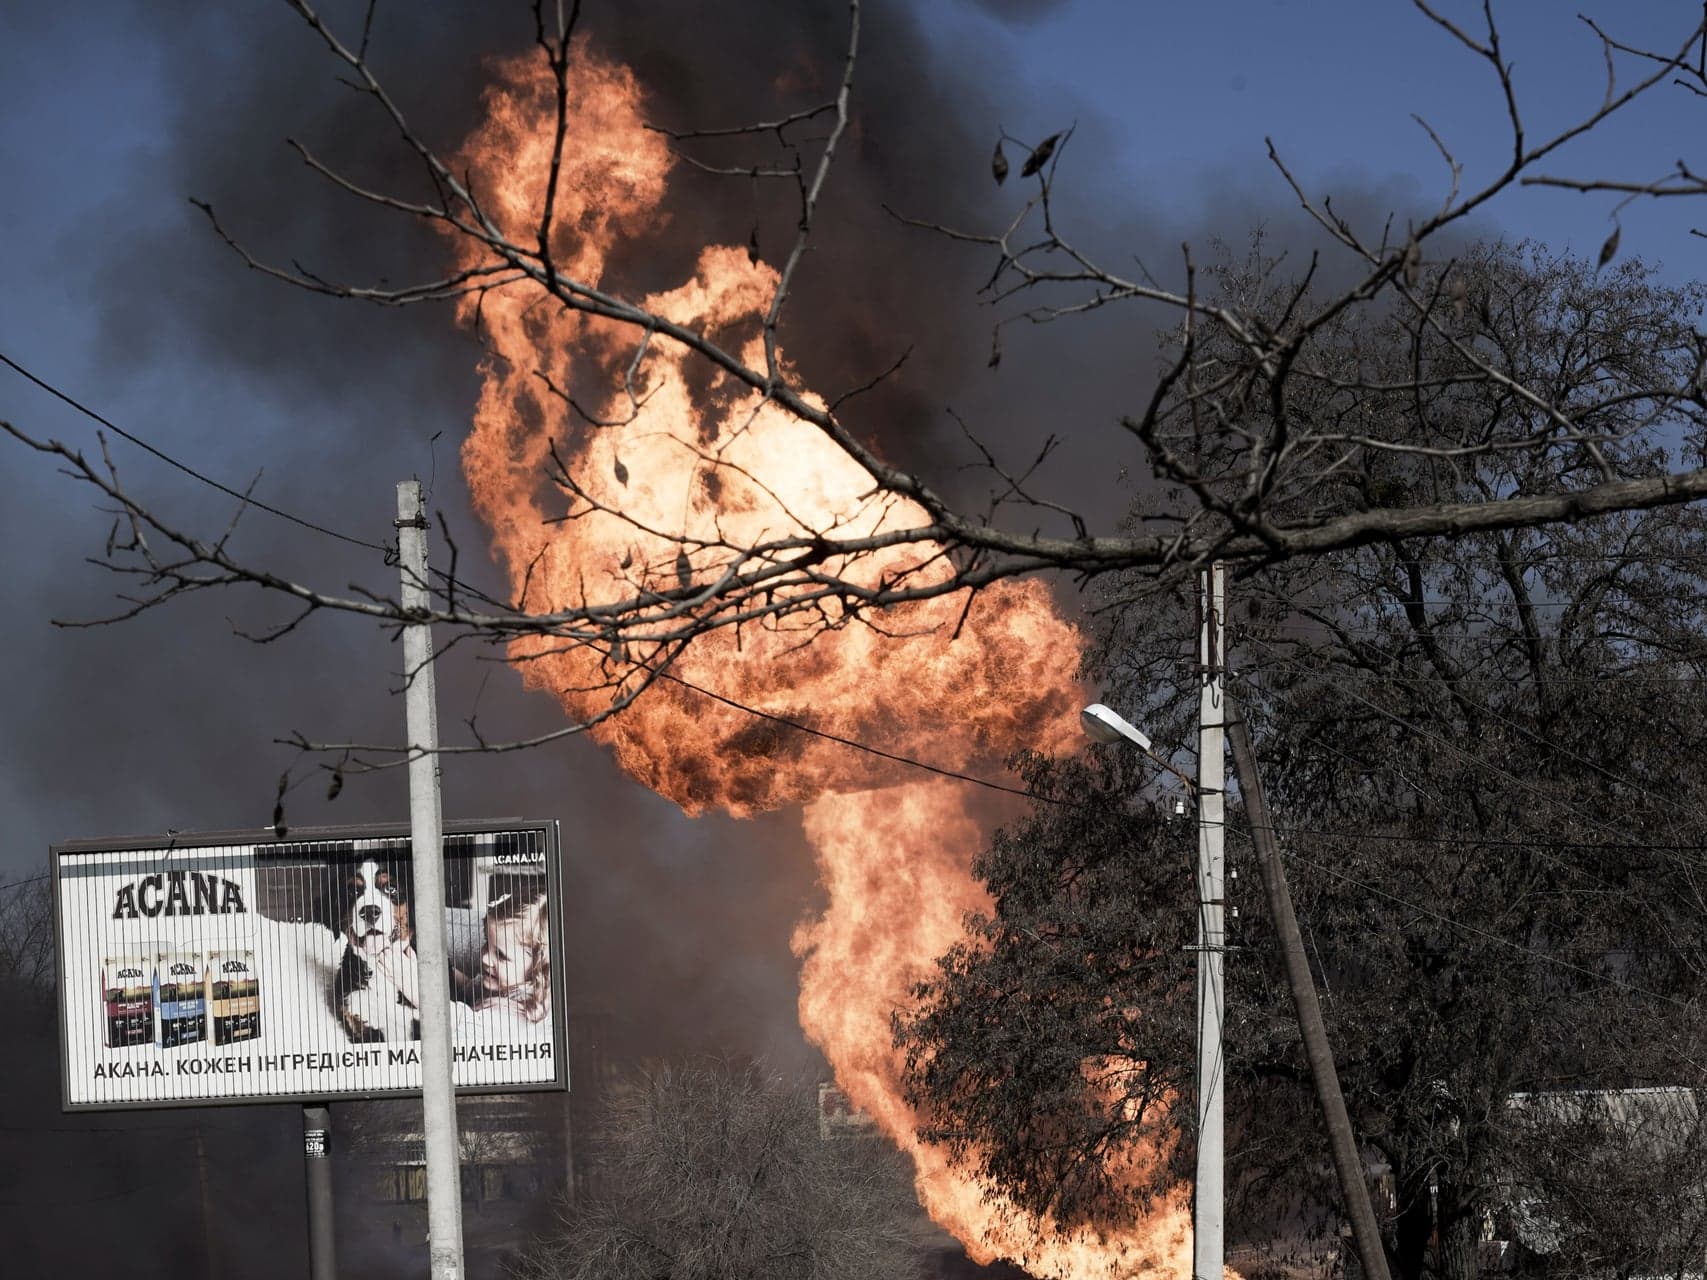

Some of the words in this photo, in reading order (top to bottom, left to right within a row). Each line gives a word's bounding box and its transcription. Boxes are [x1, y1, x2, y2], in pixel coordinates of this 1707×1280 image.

[113, 870, 247, 919] ACANA
[94, 1060, 170, 1079] АКАНА.
[177, 1056, 251, 1076] КОЖЕН
[258, 1049, 381, 1073] ІНГРЕДІЄНТ
[388, 1048, 420, 1066] МА
[452, 1042, 552, 1063] НАЧЕННЯ
